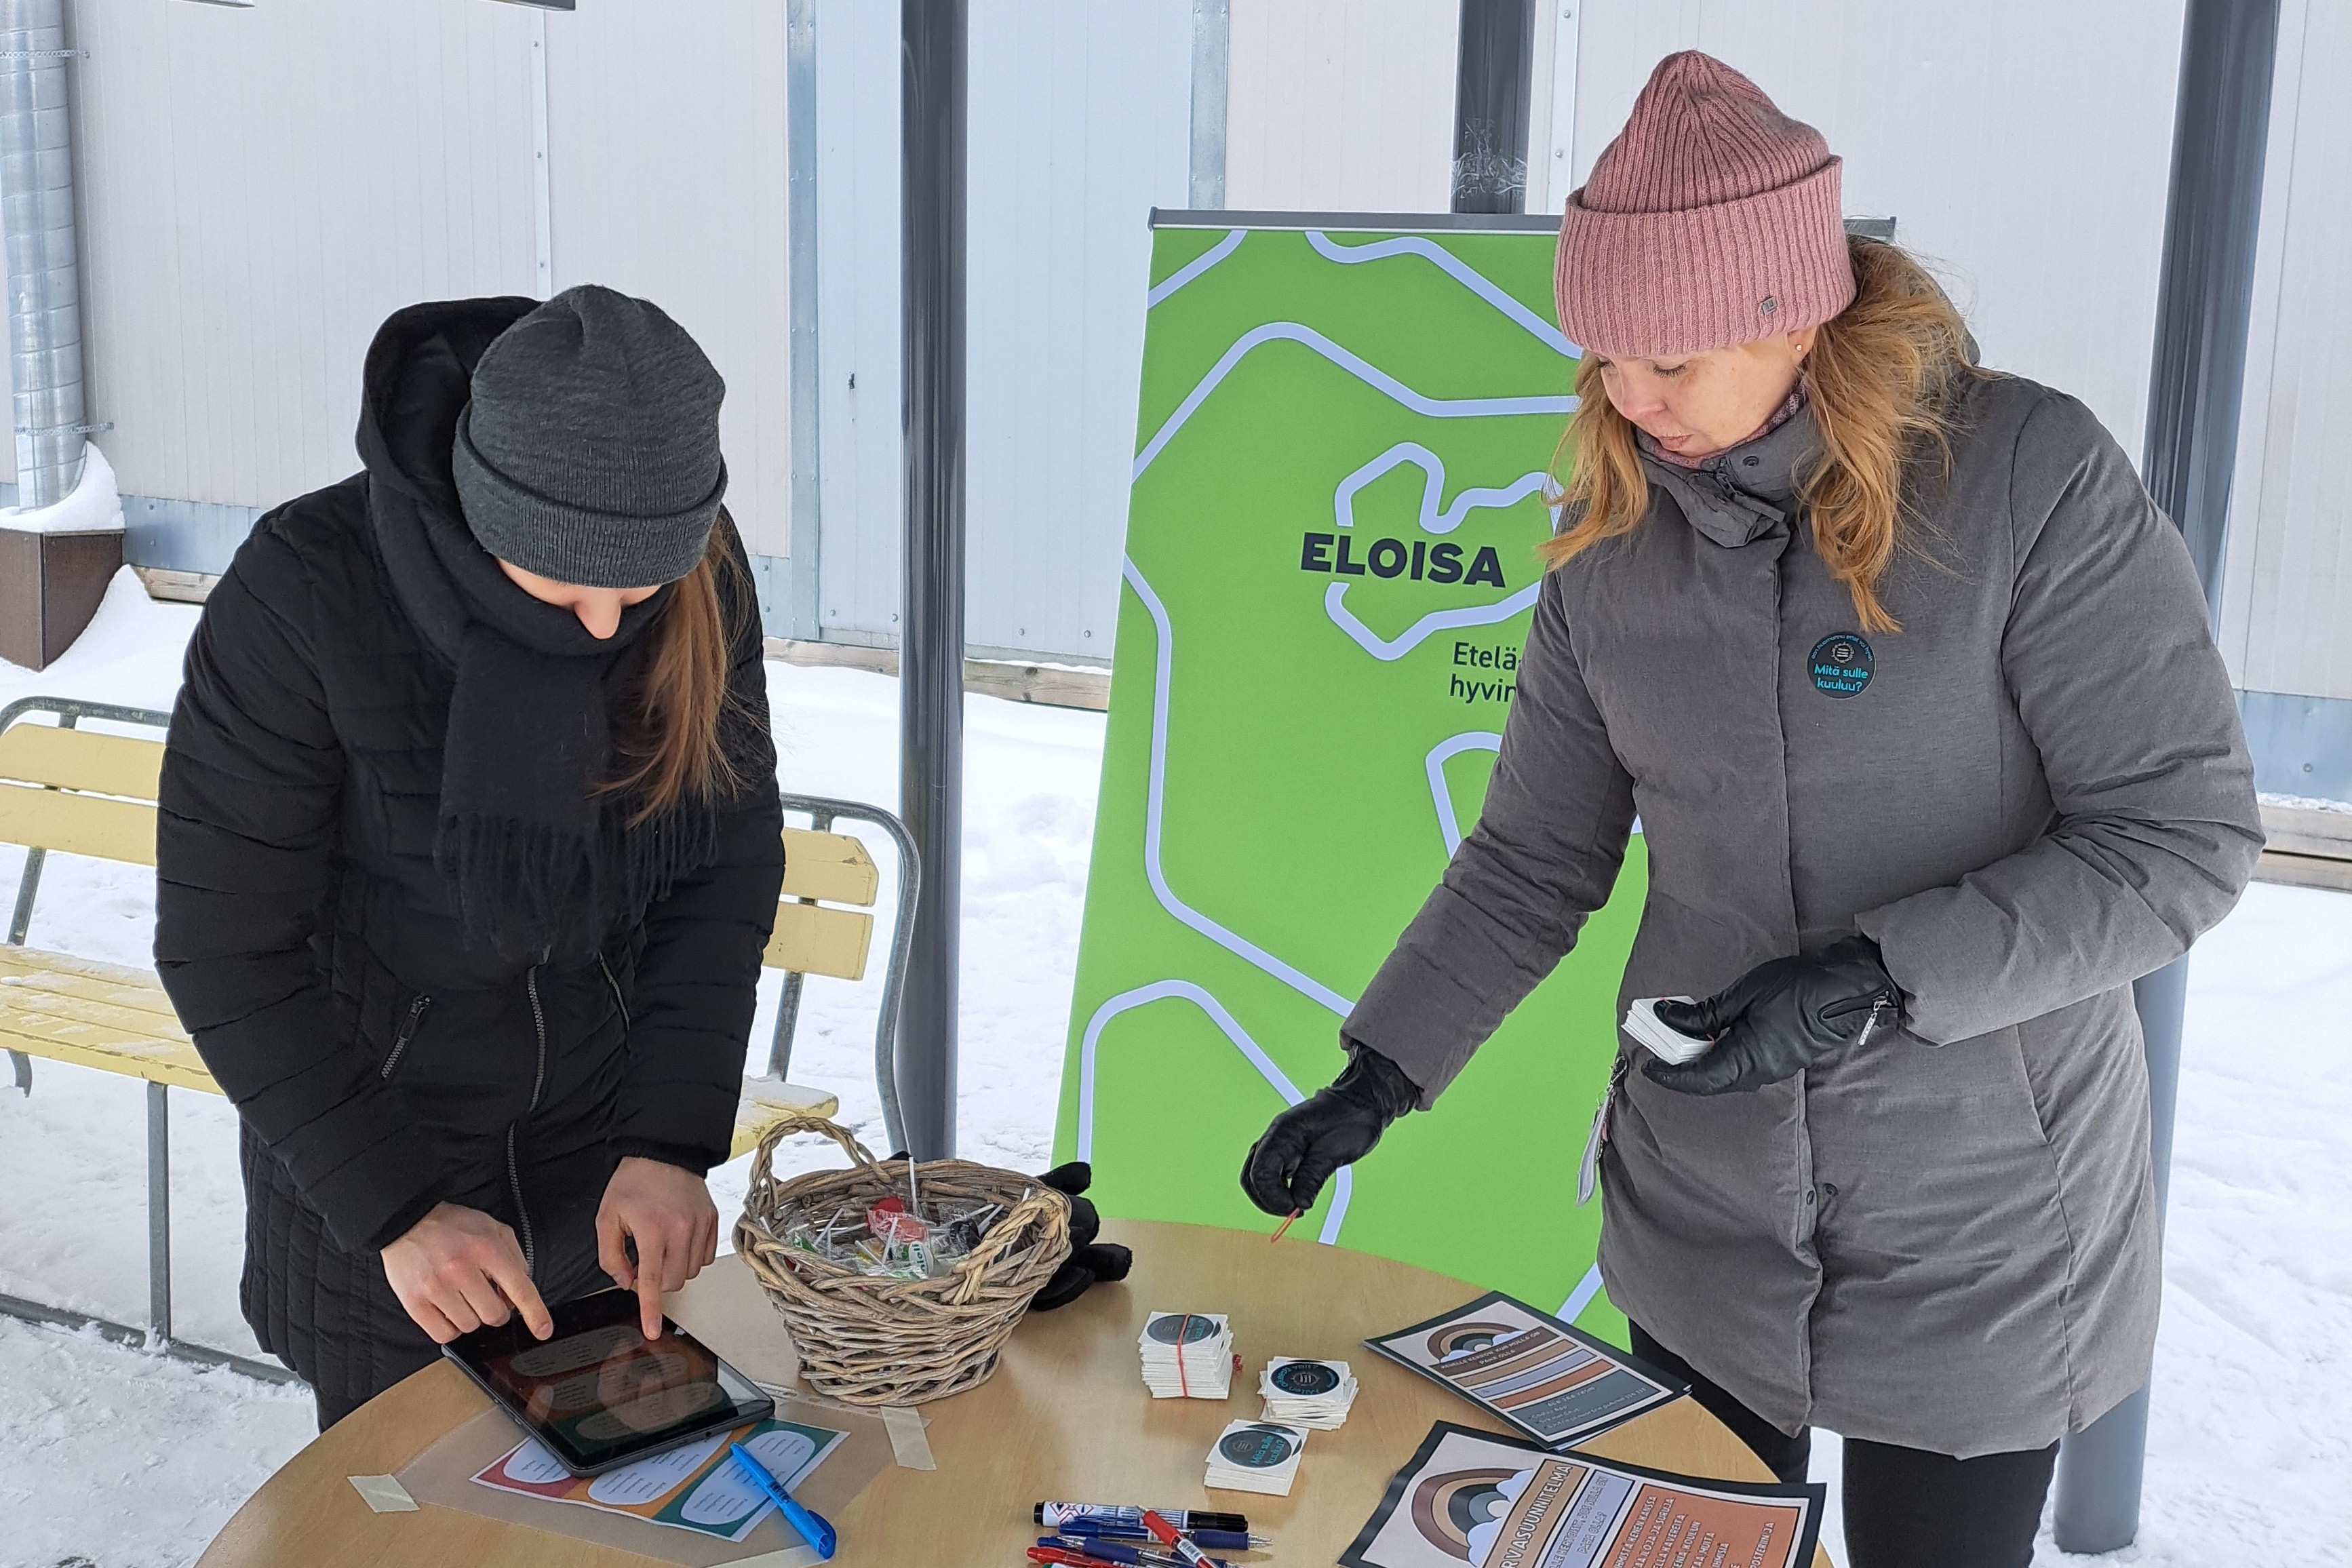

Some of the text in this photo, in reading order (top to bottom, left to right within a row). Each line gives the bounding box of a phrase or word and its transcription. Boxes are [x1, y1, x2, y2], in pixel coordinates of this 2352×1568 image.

[1300, 532, 1506, 588] ELOISA
[1814, 663, 1868, 679] Mitä sulle
[1817, 677, 1863, 692] kuuluu?
[1627, 1521, 1645, 1542] KENEN
[1638, 1496, 1657, 1521] KANSSA
[1763, 1522, 1775, 1534] JA
[1640, 1536, 1657, 1557] ILOJA
[1650, 1525, 1662, 1535] JA
[1681, 1521, 1701, 1550] KOULUN
[1698, 1532, 1715, 1554] MUITA
